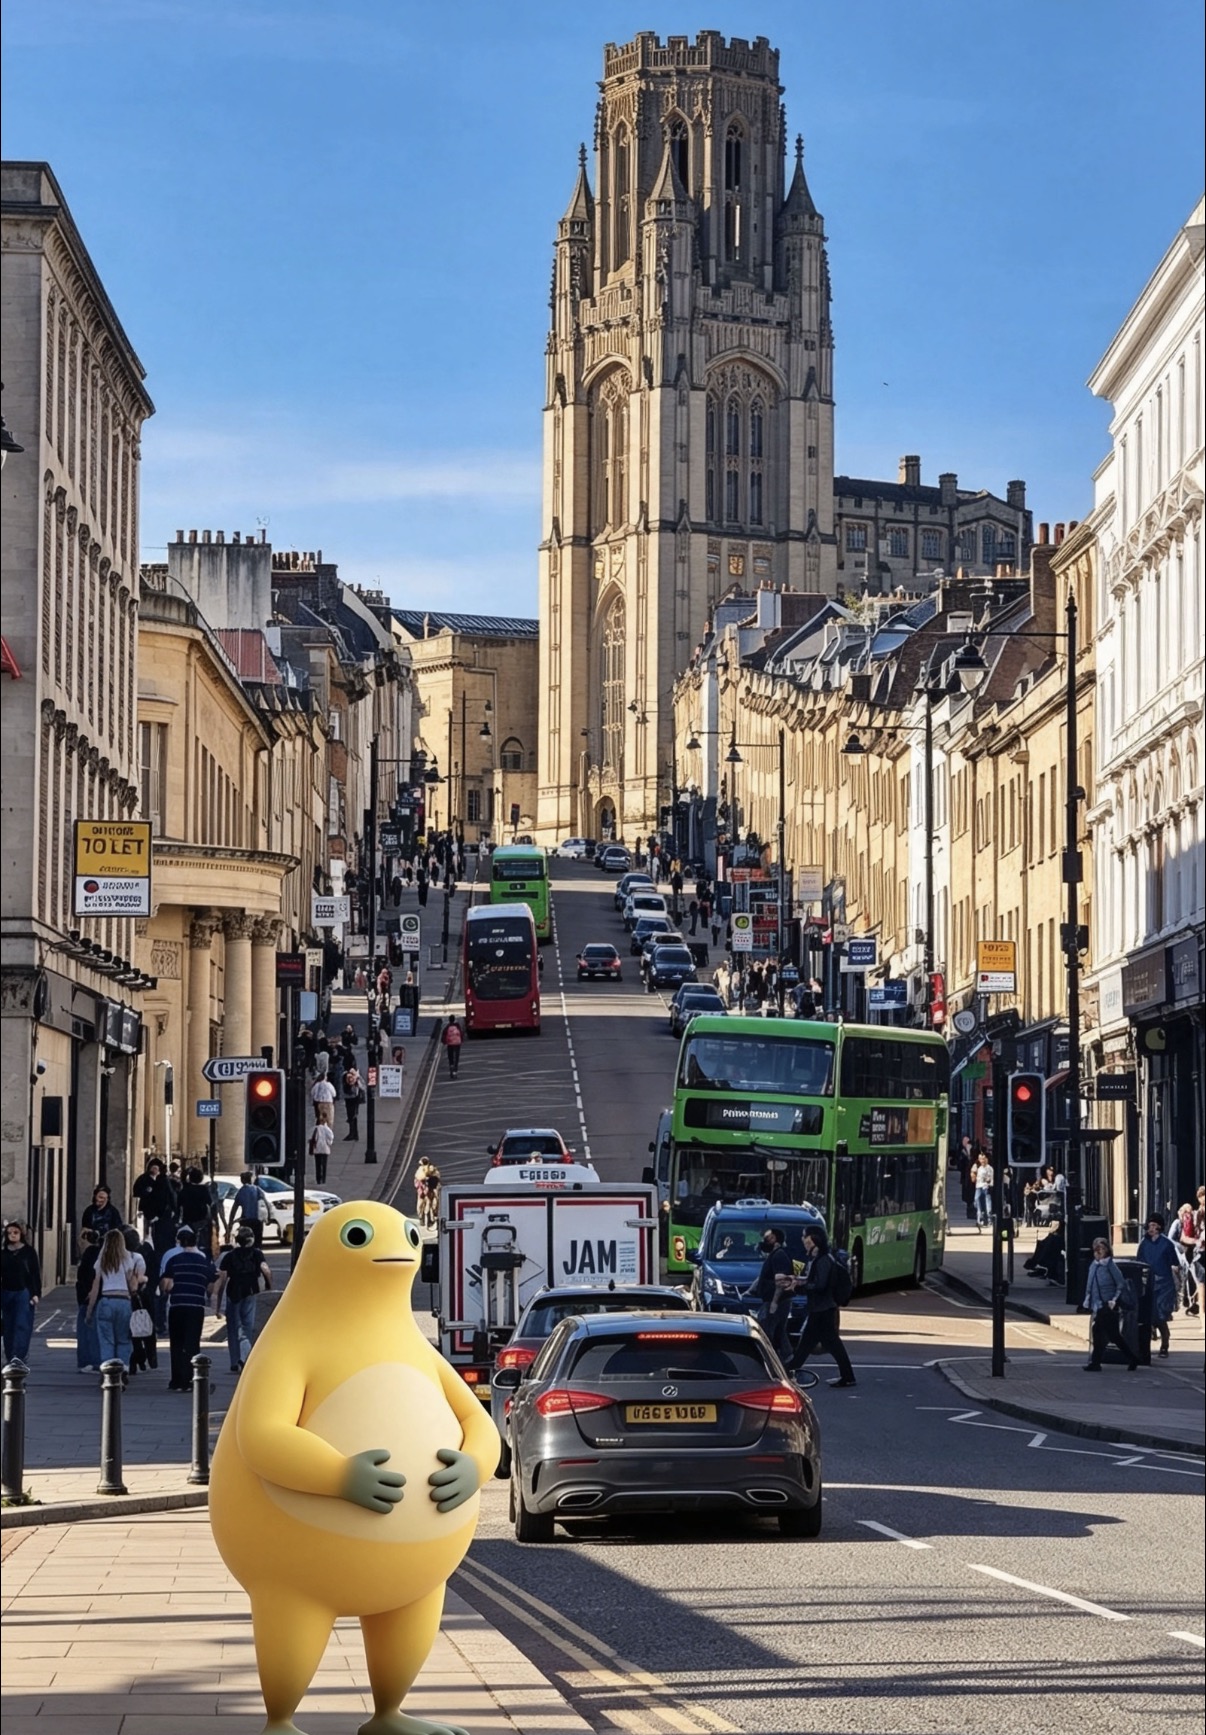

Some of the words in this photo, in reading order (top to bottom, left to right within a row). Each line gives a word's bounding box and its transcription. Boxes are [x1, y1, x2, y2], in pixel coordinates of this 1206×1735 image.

[82, 838, 106, 854] TO
[110, 838, 144, 855] LET
[562, 1240, 617, 1275] JAM
